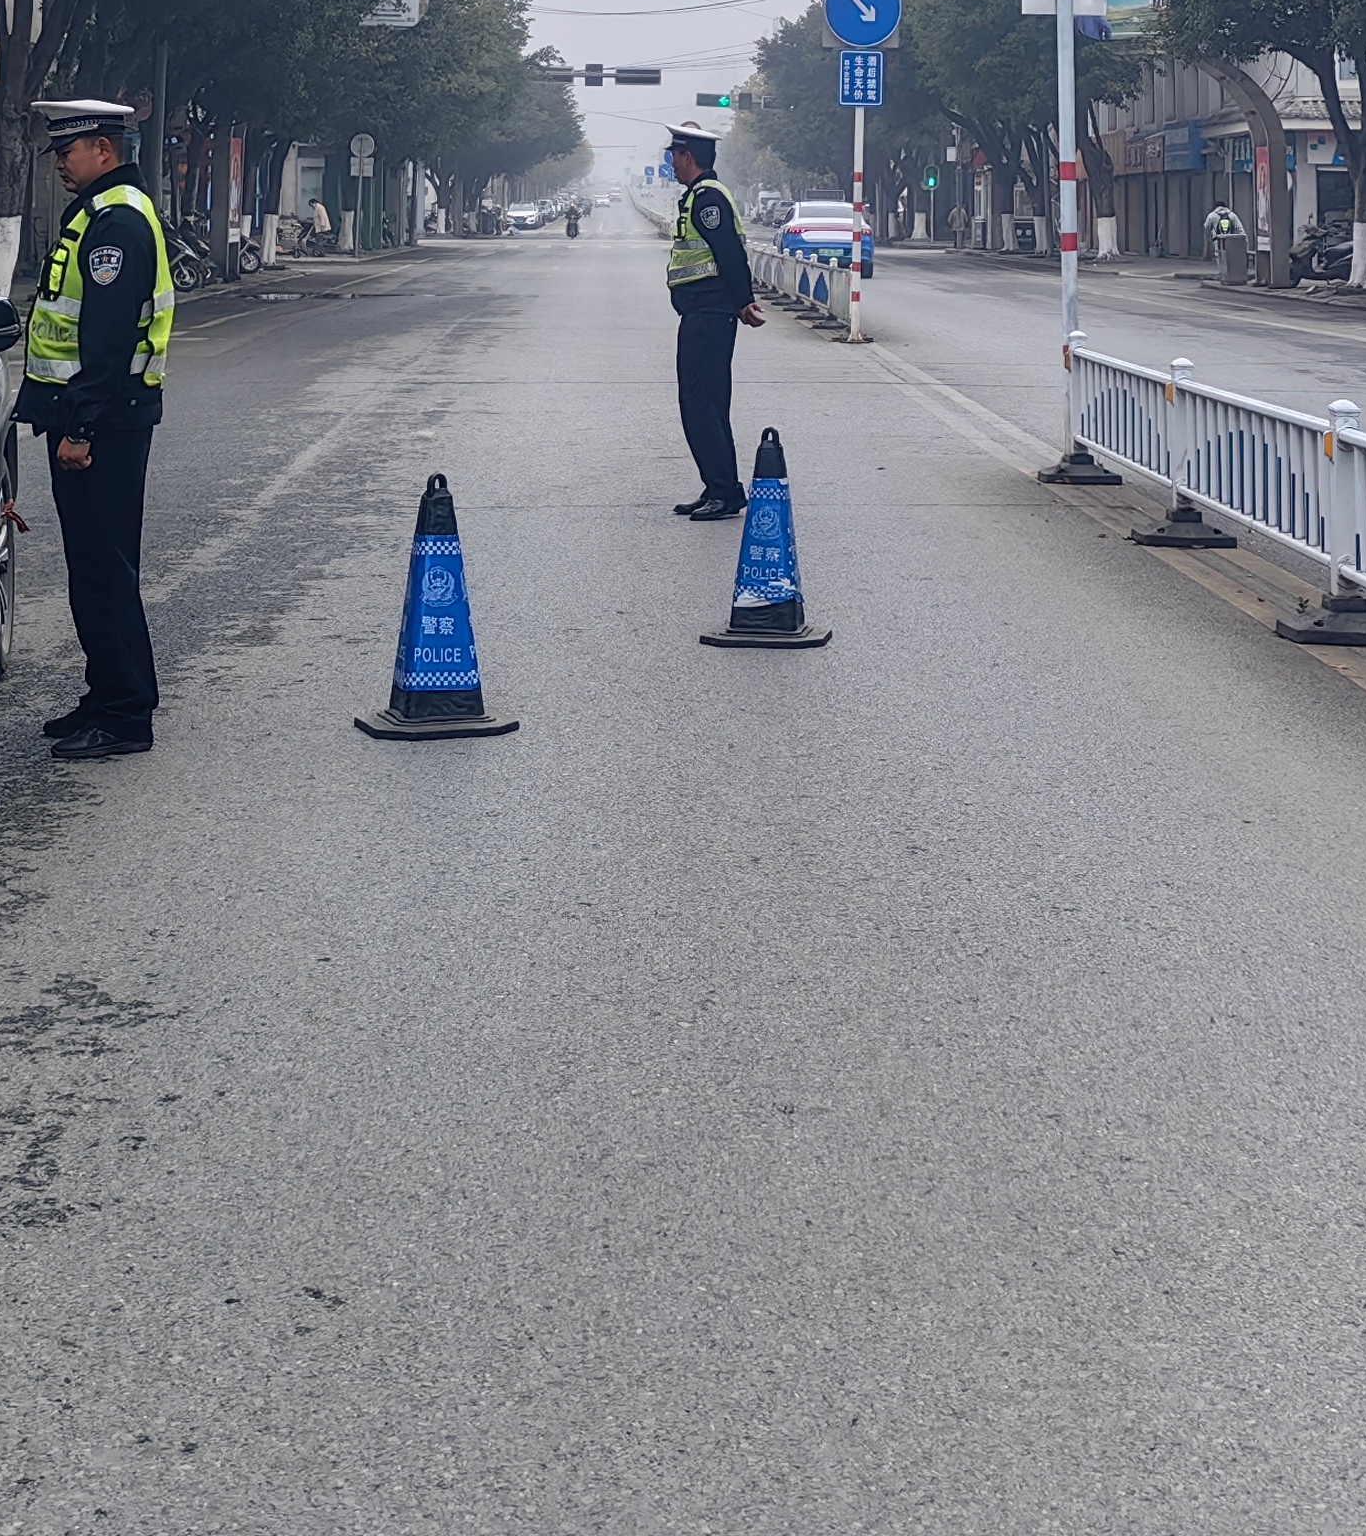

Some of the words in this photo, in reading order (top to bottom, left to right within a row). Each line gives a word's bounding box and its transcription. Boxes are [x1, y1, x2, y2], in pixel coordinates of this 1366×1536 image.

[749, 545, 781, 562] 警察
[743, 566, 785, 580] POLICE
[421, 615, 455, 635] 警察
[414, 647, 462, 663] POLICE
